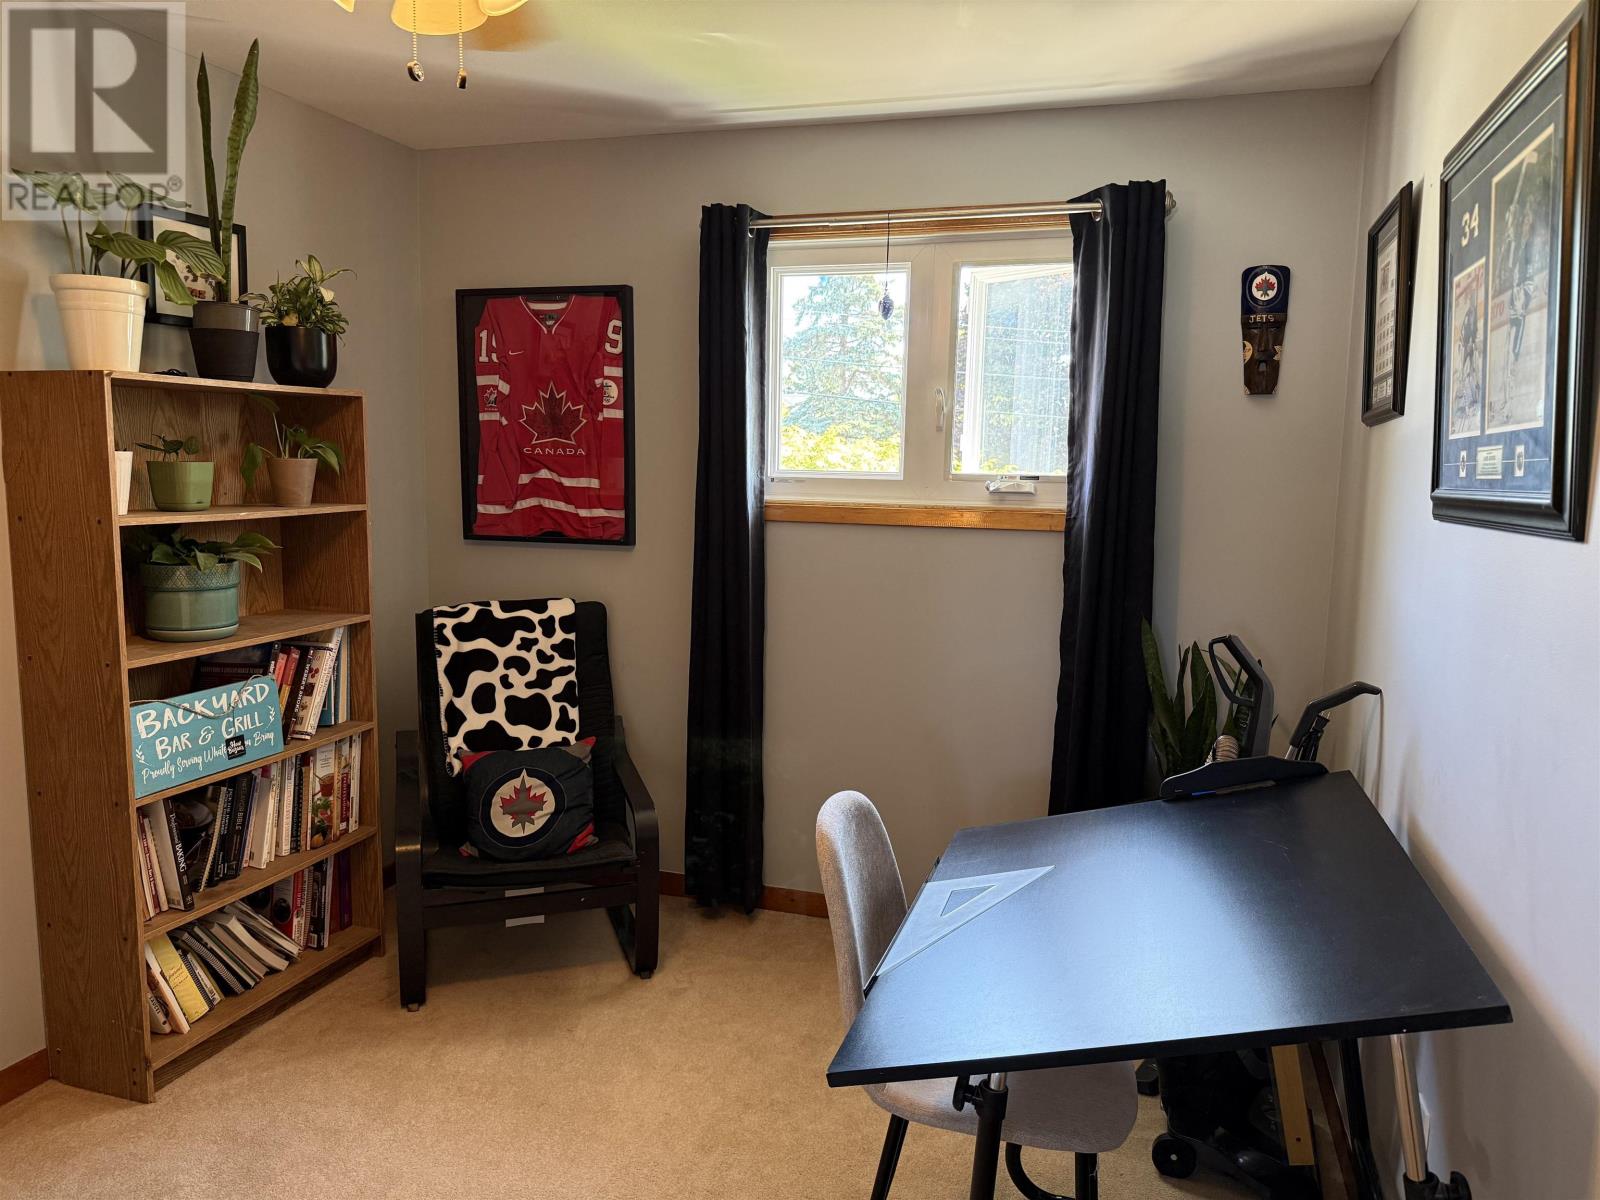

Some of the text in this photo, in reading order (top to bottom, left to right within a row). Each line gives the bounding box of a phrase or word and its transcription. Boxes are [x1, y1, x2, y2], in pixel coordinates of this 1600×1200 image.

[1461, 203, 1479, 248] 34
[1248, 314, 1275, 323] JETS
[523, 447, 586, 456] CANADA
[136, 683, 270, 739] BACKYARD
[141, 764, 175, 784] Proudly
[176, 753, 203, 771] Serving
[253, 731, 274, 747] Bring
[155, 711, 264, 760] BAR & GRILL
[175, 843, 187, 873] BAKING
